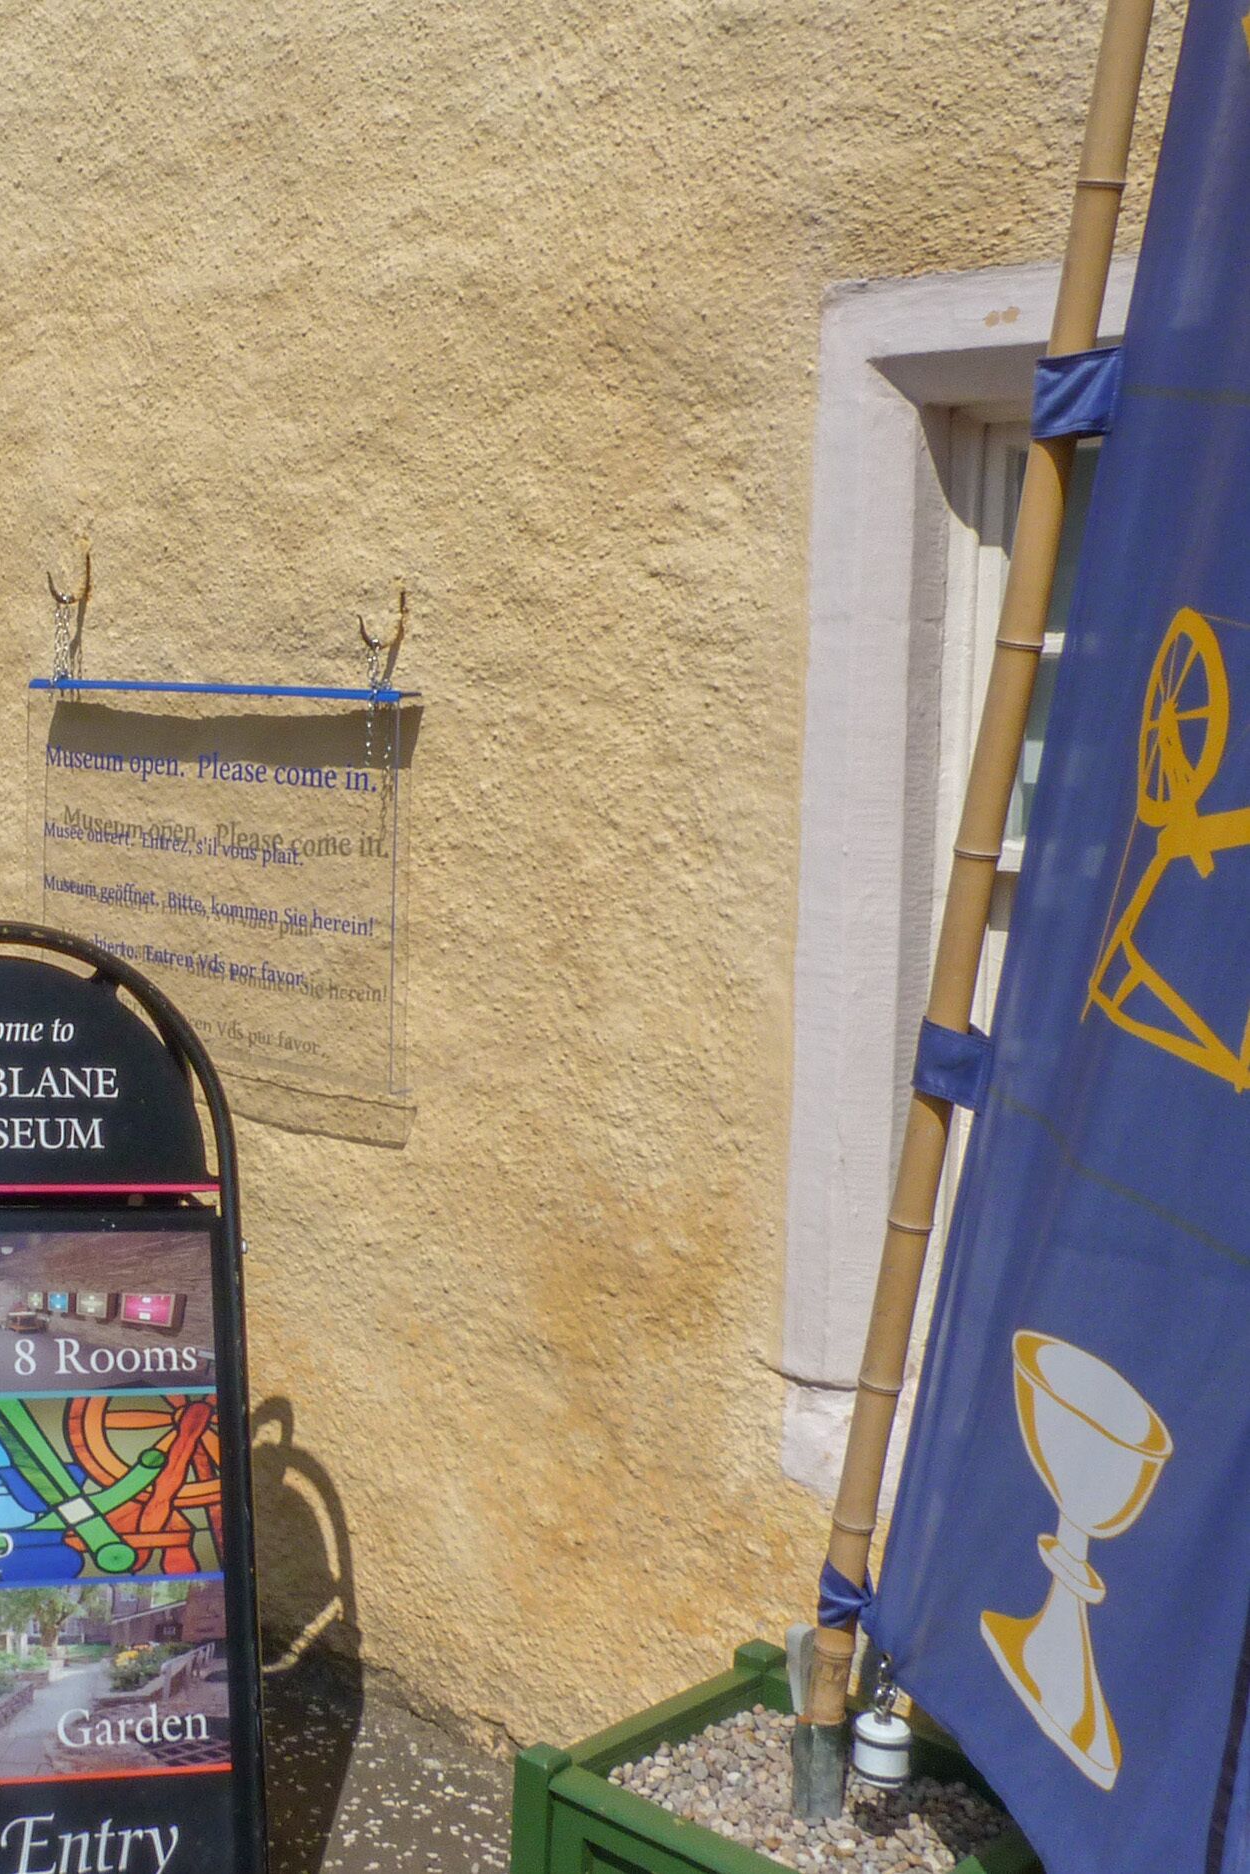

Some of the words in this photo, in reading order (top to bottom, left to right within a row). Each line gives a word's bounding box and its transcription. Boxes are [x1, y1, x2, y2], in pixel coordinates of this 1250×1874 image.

[45, 743, 124, 773] Museum
[129, 754, 185, 782] open.
[197, 751, 268, 783] Please
[274, 764, 338, 789] come
[344, 763, 378, 793] in.
[222, 844, 257, 860] vous
[43, 873, 97, 897] Museum
[211, 895, 279, 924] kommen
[283, 907, 308, 927] Sie
[312, 908, 375, 937] herein!
[229, 962, 257, 981] por
[51, 1019, 75, 1043] to
[13, 1338, 37, 1376] 8
[54, 1337, 198, 1375] Rooms
[56, 1702, 210, 1748] Garden
[0, 1812, 180, 1874] Entry
